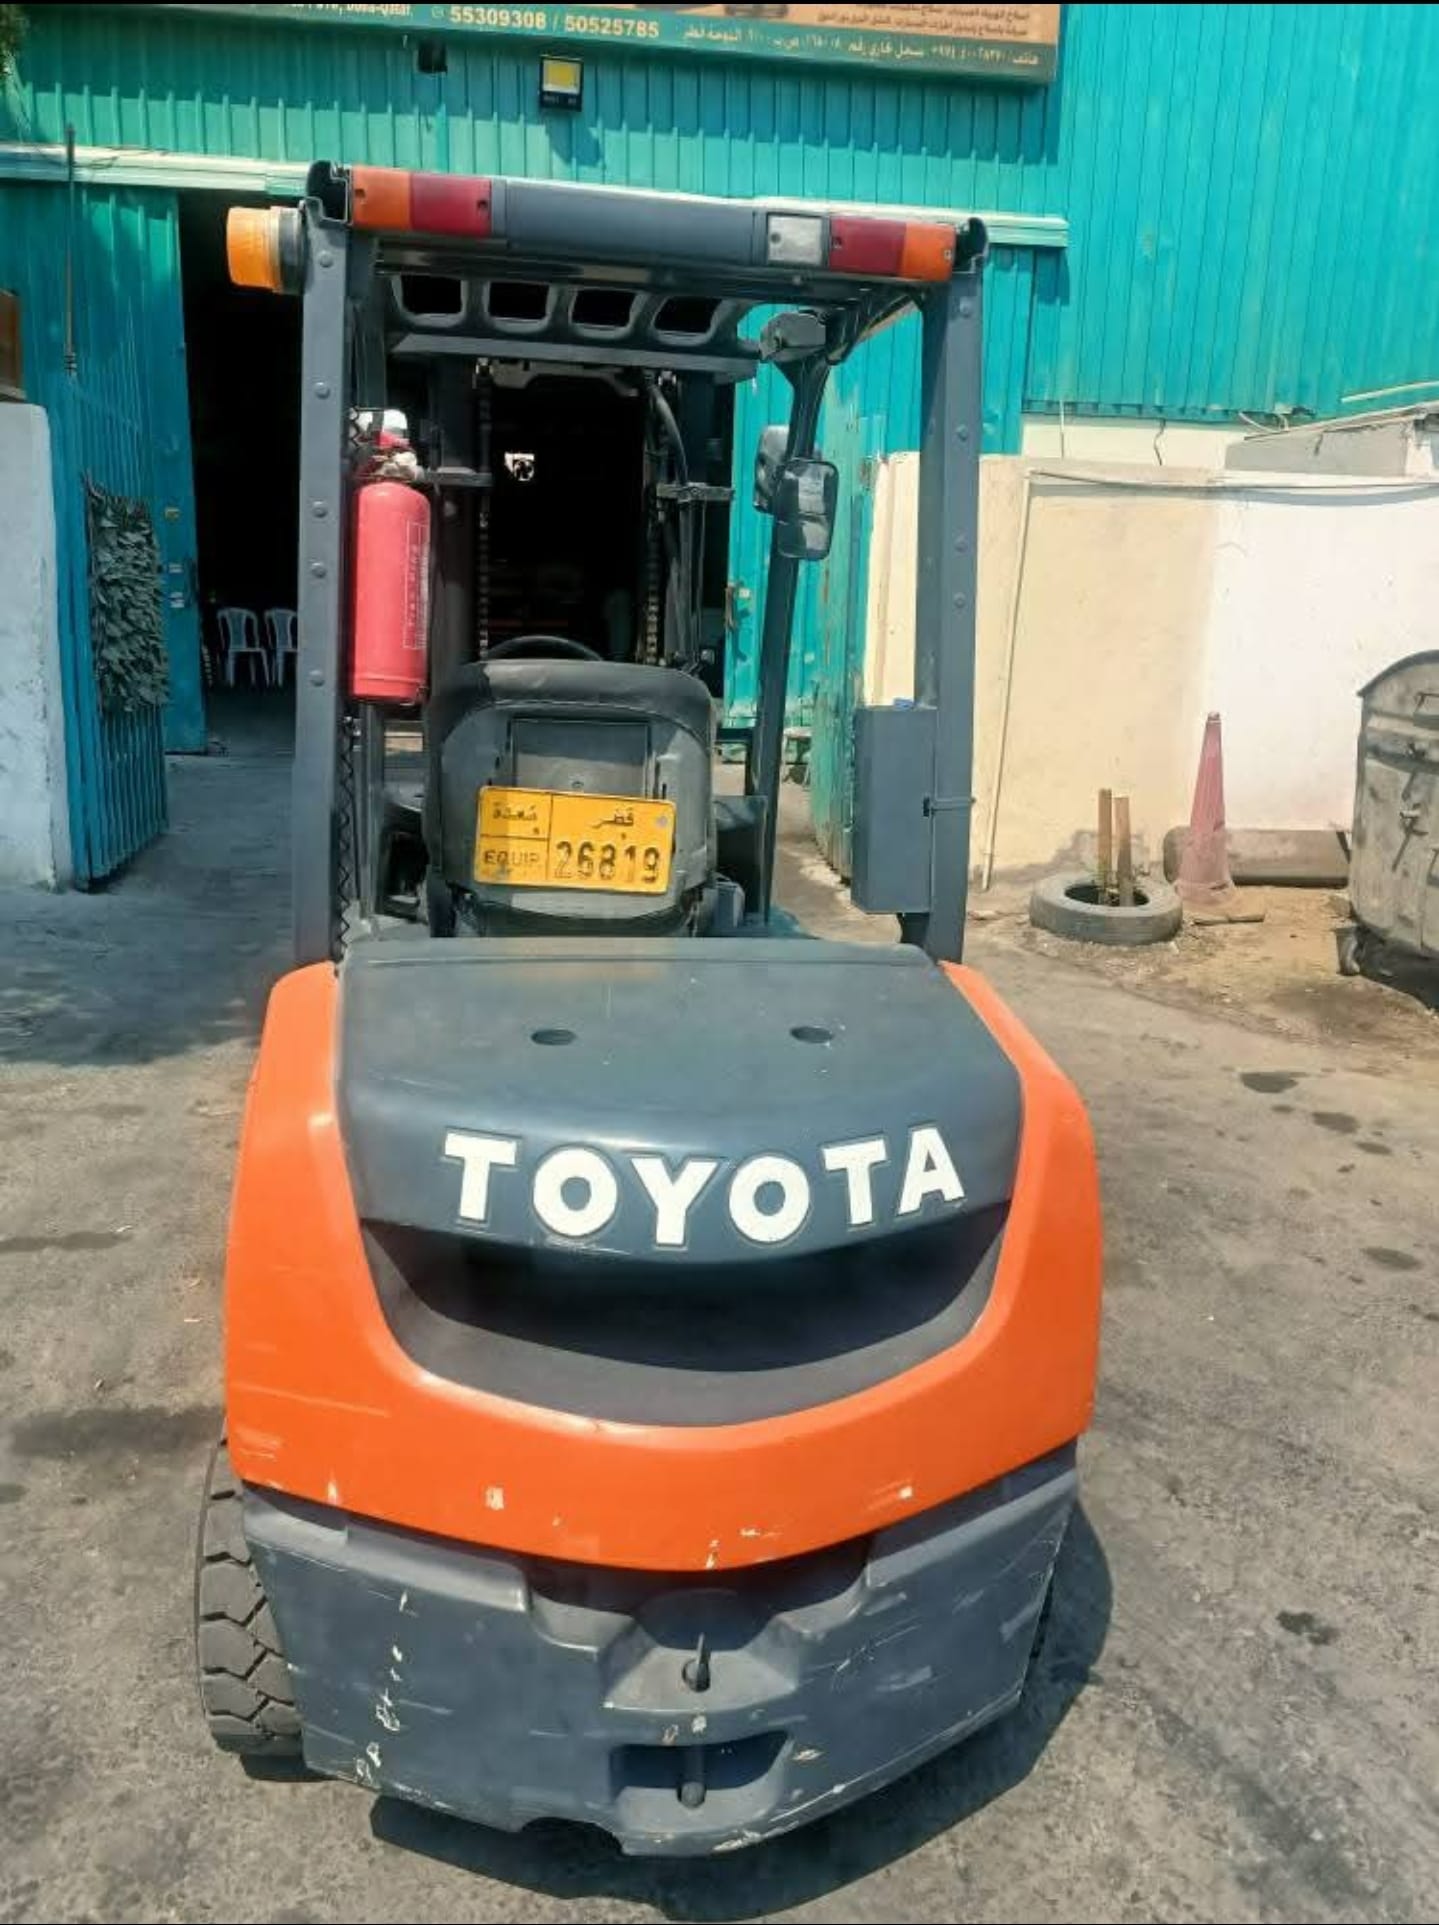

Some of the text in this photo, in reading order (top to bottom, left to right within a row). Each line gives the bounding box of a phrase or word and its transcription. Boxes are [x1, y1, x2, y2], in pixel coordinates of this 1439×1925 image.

[450, 5, 546, 30] 55309308
[565, 15, 660, 39] 50525785
[553, 840, 661, 883] 26819
[442, 1124, 966, 1248] TOYOTA
